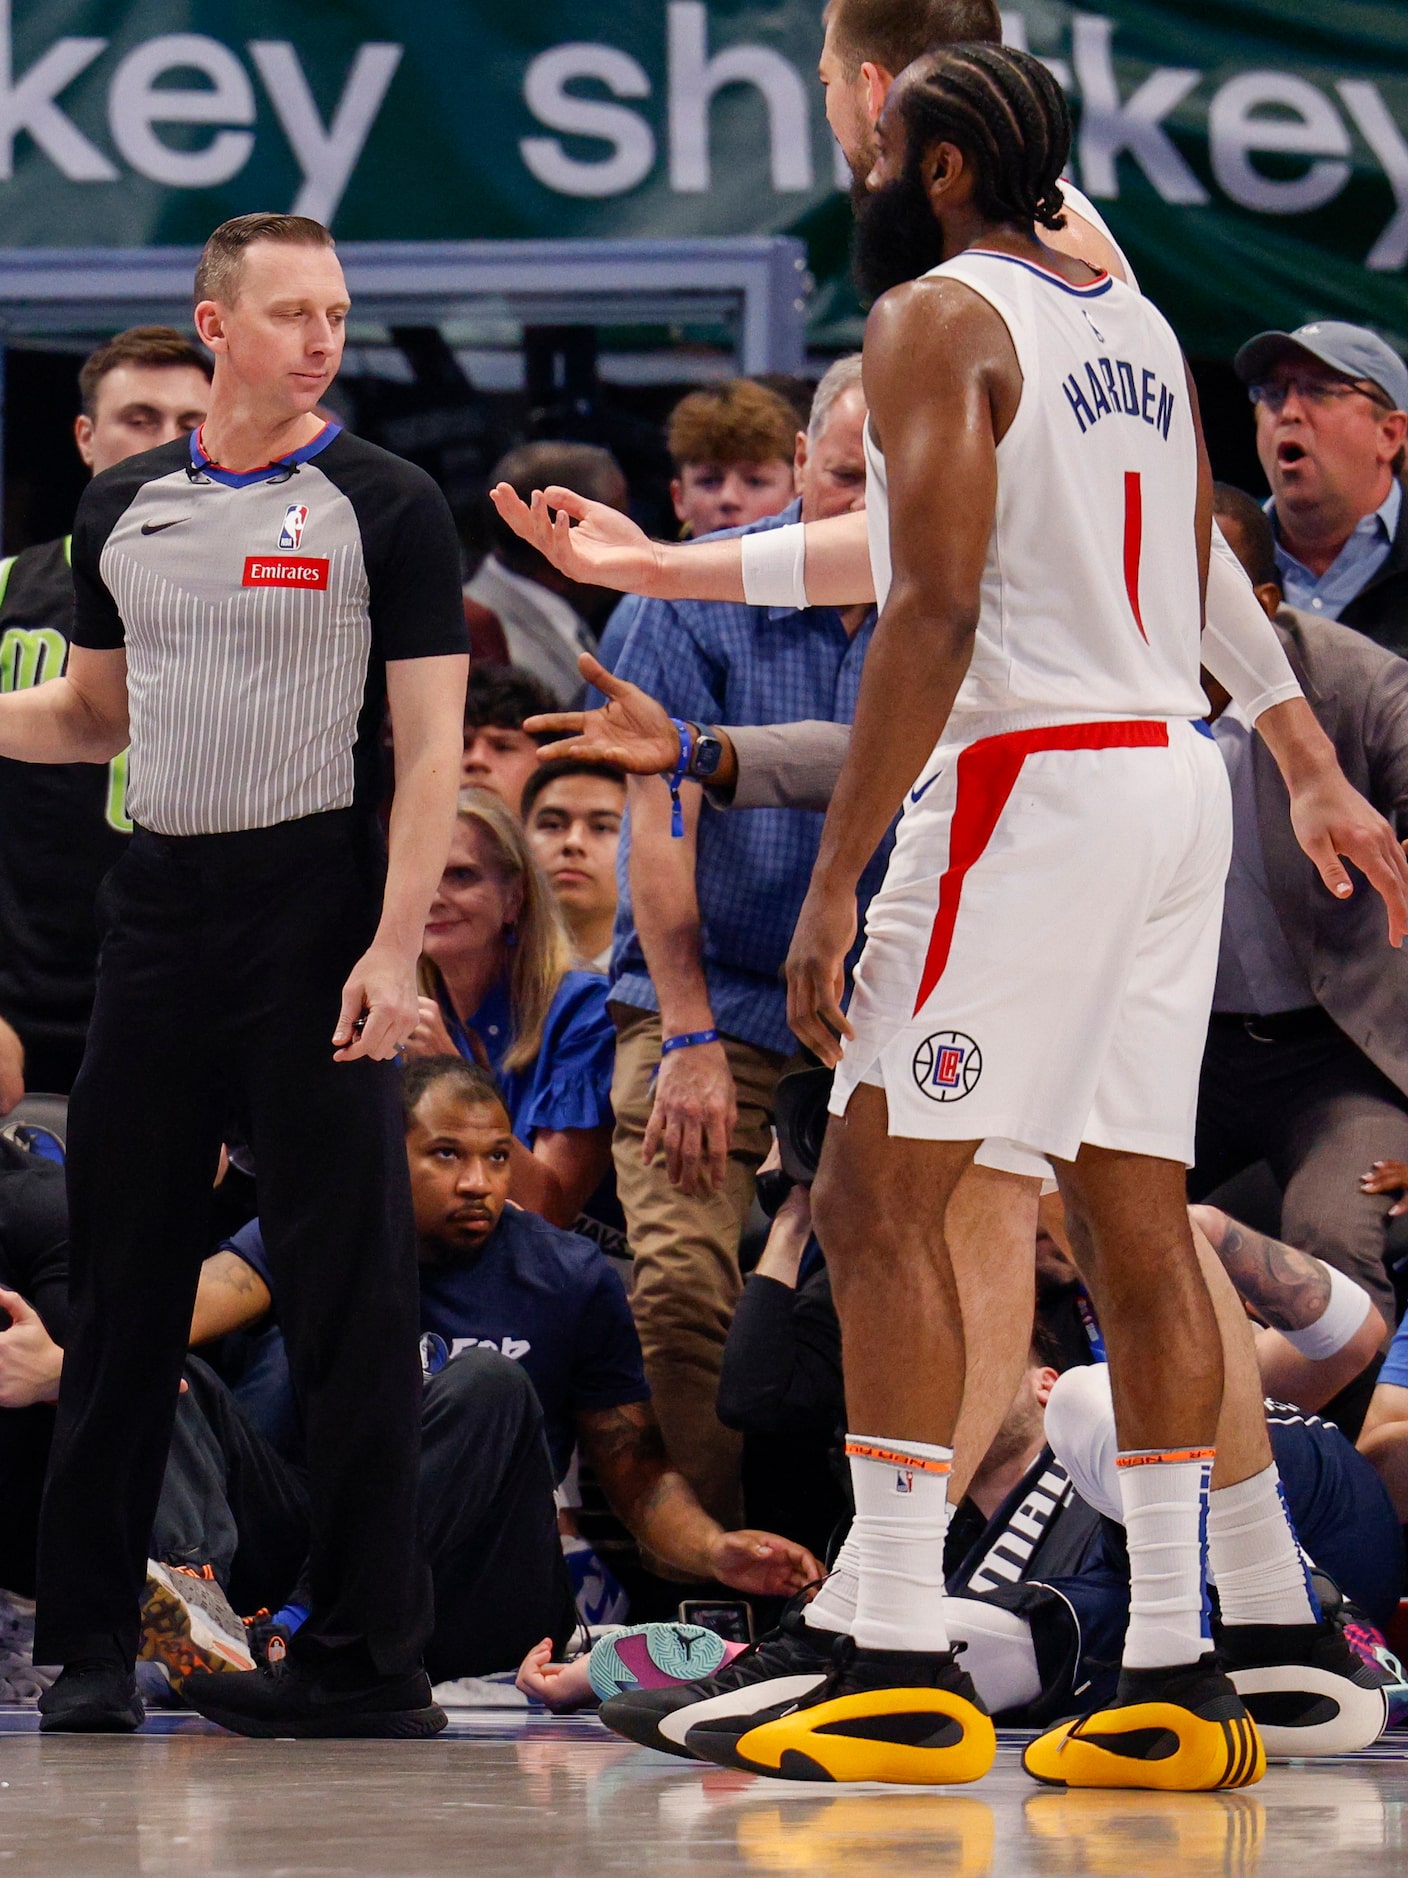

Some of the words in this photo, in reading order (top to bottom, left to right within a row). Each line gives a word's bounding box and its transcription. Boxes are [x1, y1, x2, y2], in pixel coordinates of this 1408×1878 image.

[1062, 357, 1175, 442] HARDEN
[251, 563, 320, 581] Emirates
[1123, 470, 1150, 646] 1
